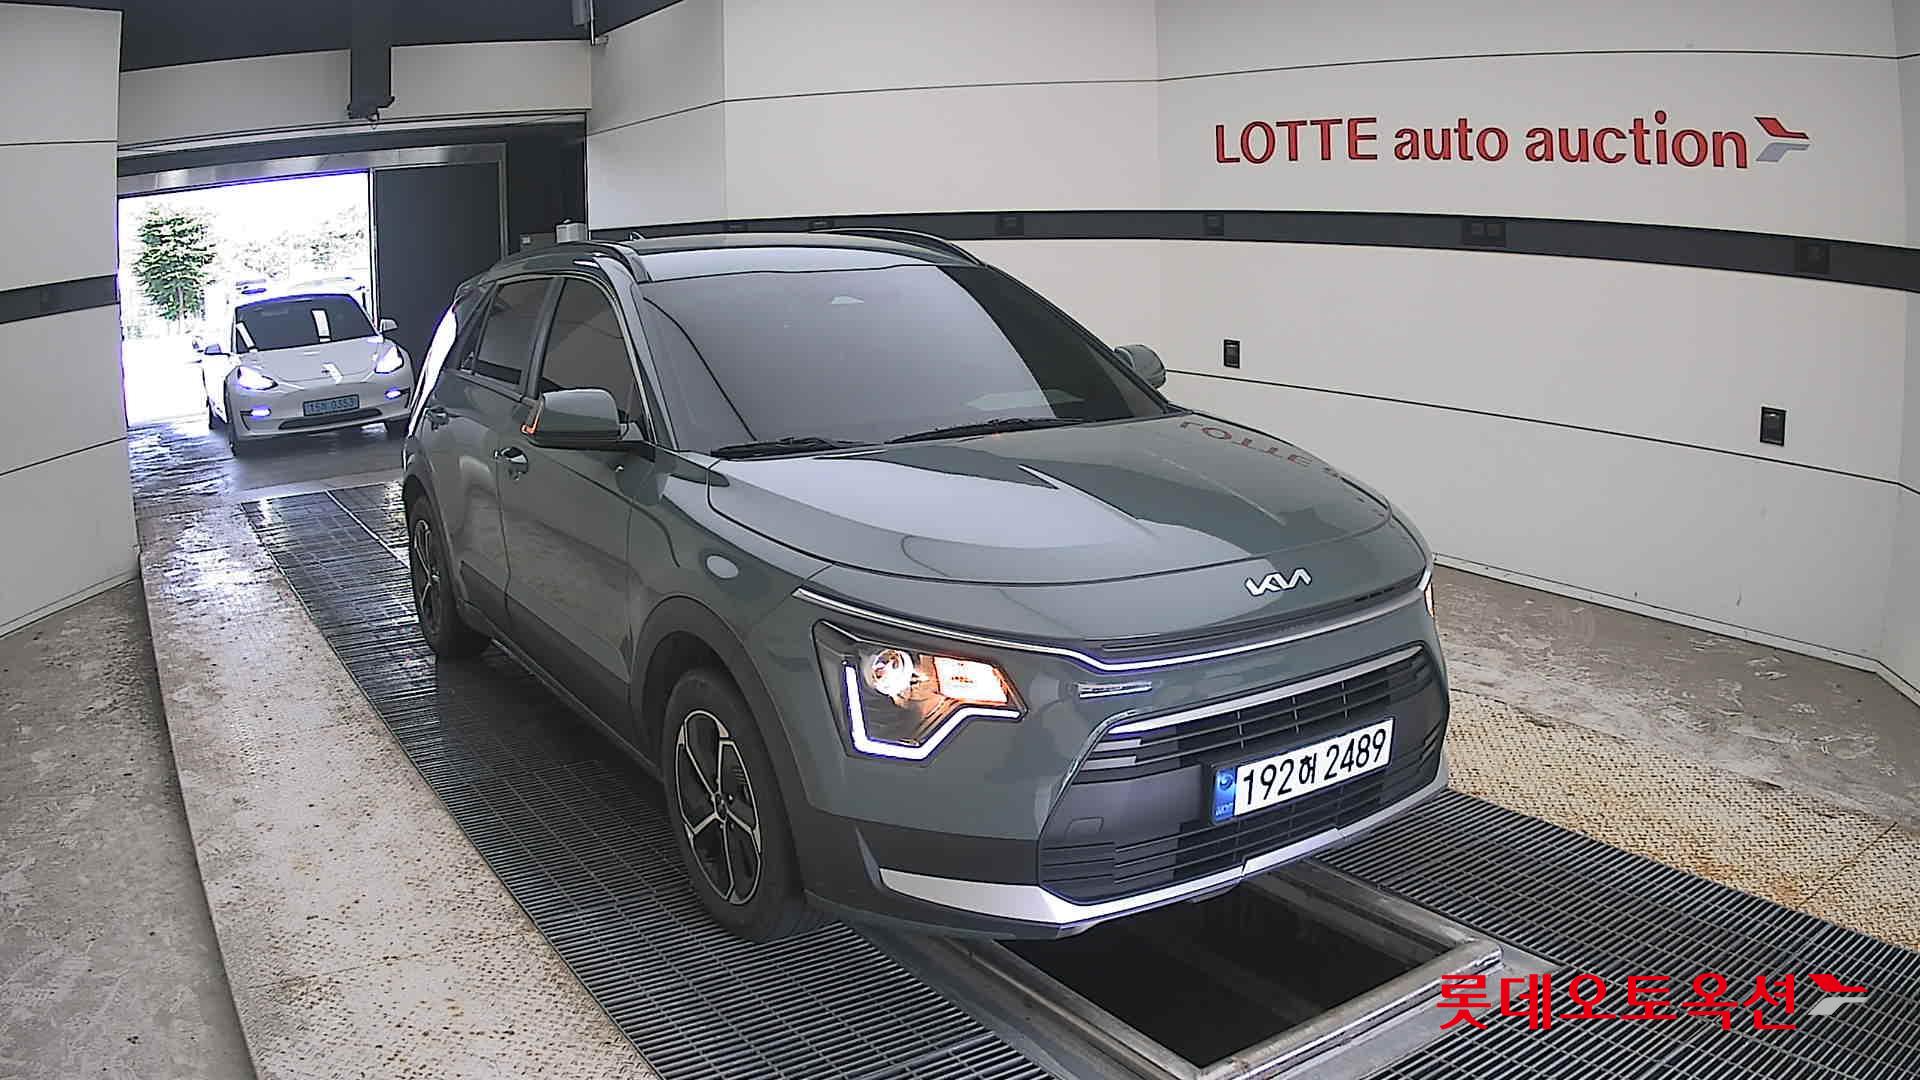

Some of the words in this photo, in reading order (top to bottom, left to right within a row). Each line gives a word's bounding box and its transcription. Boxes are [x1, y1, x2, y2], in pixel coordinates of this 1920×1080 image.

[1215, 117, 1379, 164] LOTTE
[1394, 118, 1509, 163] auto
[1525, 110, 1748, 169] auction
[1245, 568, 1312, 596] KIA
[1243, 752, 1317, 805] 192허
[1323, 728, 1386, 781] 2489
